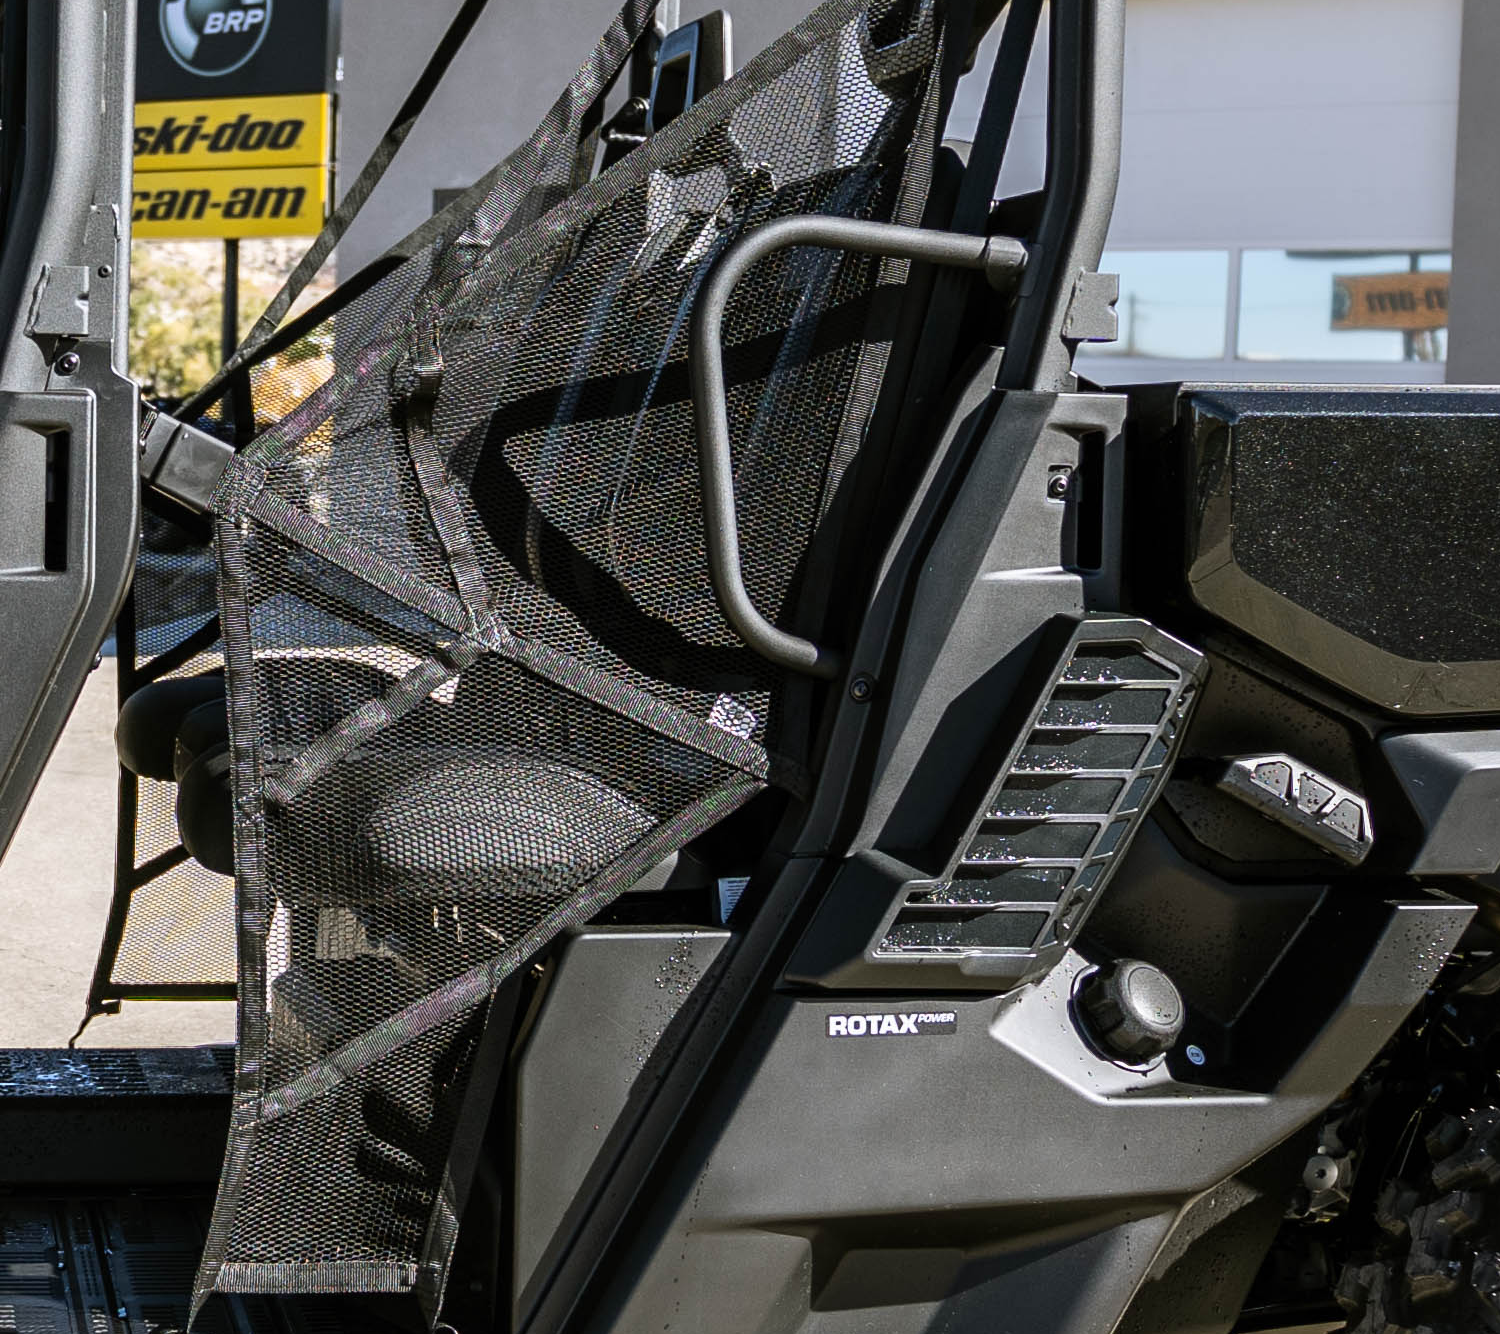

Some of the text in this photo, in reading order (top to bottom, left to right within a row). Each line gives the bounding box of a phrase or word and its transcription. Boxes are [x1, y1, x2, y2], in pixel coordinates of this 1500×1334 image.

[203, 7, 265, 35] BRP
[133, 113, 305, 157] ski-doo
[131, 186, 307, 222] can-am
[828, 1012, 956, 1036] ROTAX POWER
